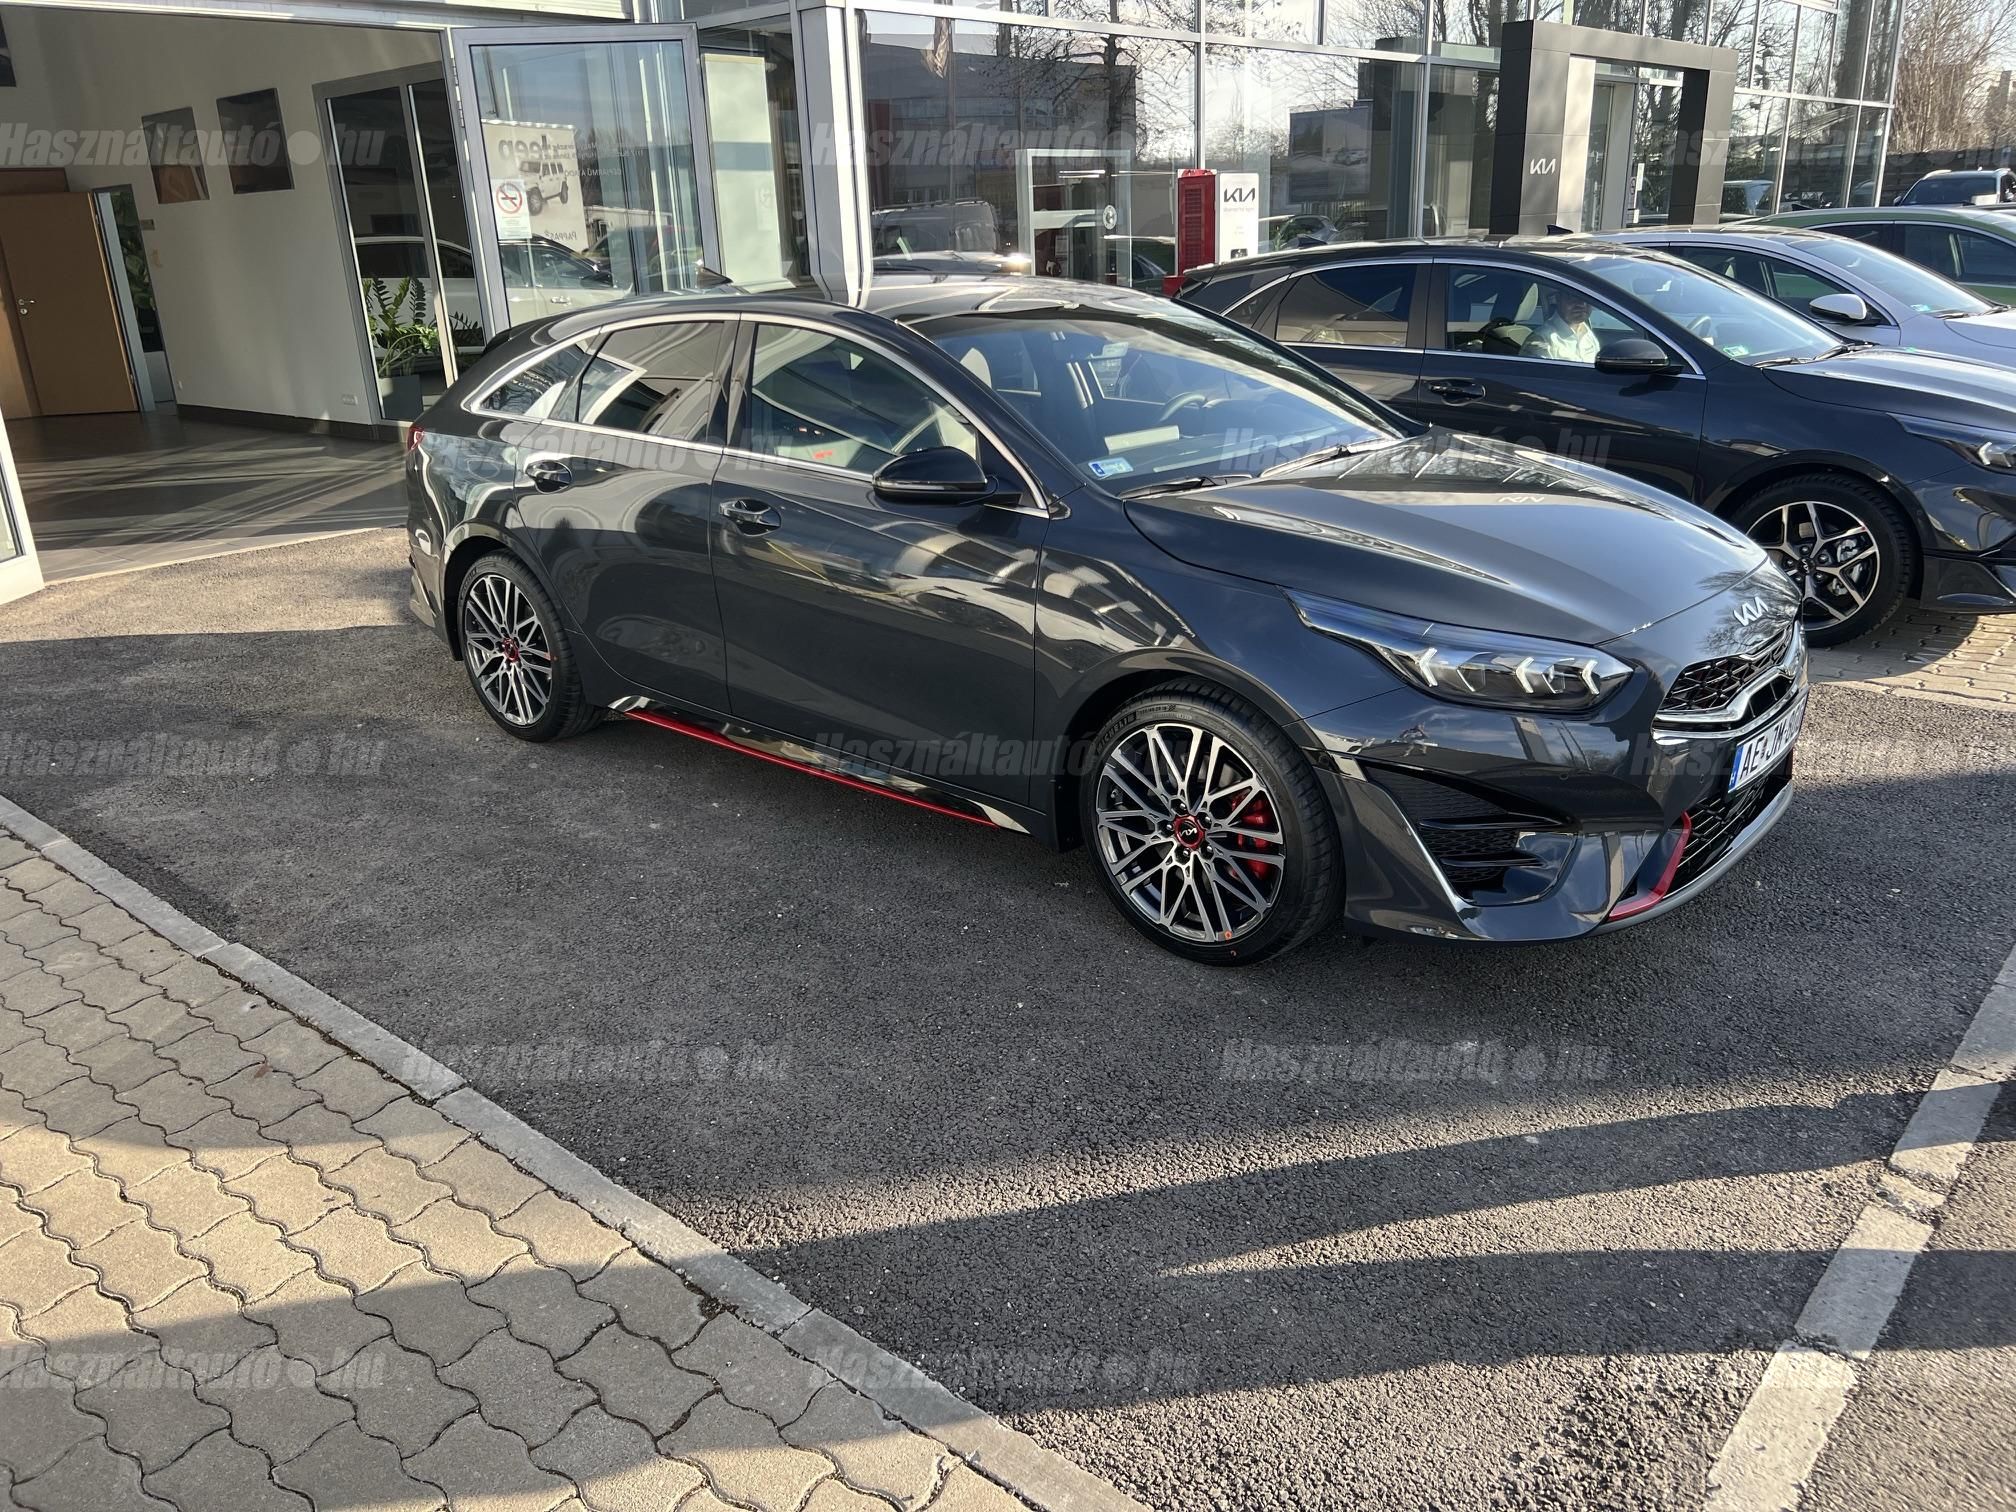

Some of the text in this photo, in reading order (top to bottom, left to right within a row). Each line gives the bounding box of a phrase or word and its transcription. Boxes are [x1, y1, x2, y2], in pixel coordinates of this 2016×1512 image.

[1530, 158, 1556, 175] KIA
[1223, 187, 1256, 203] KIA
[1733, 596, 1769, 627] KIA
